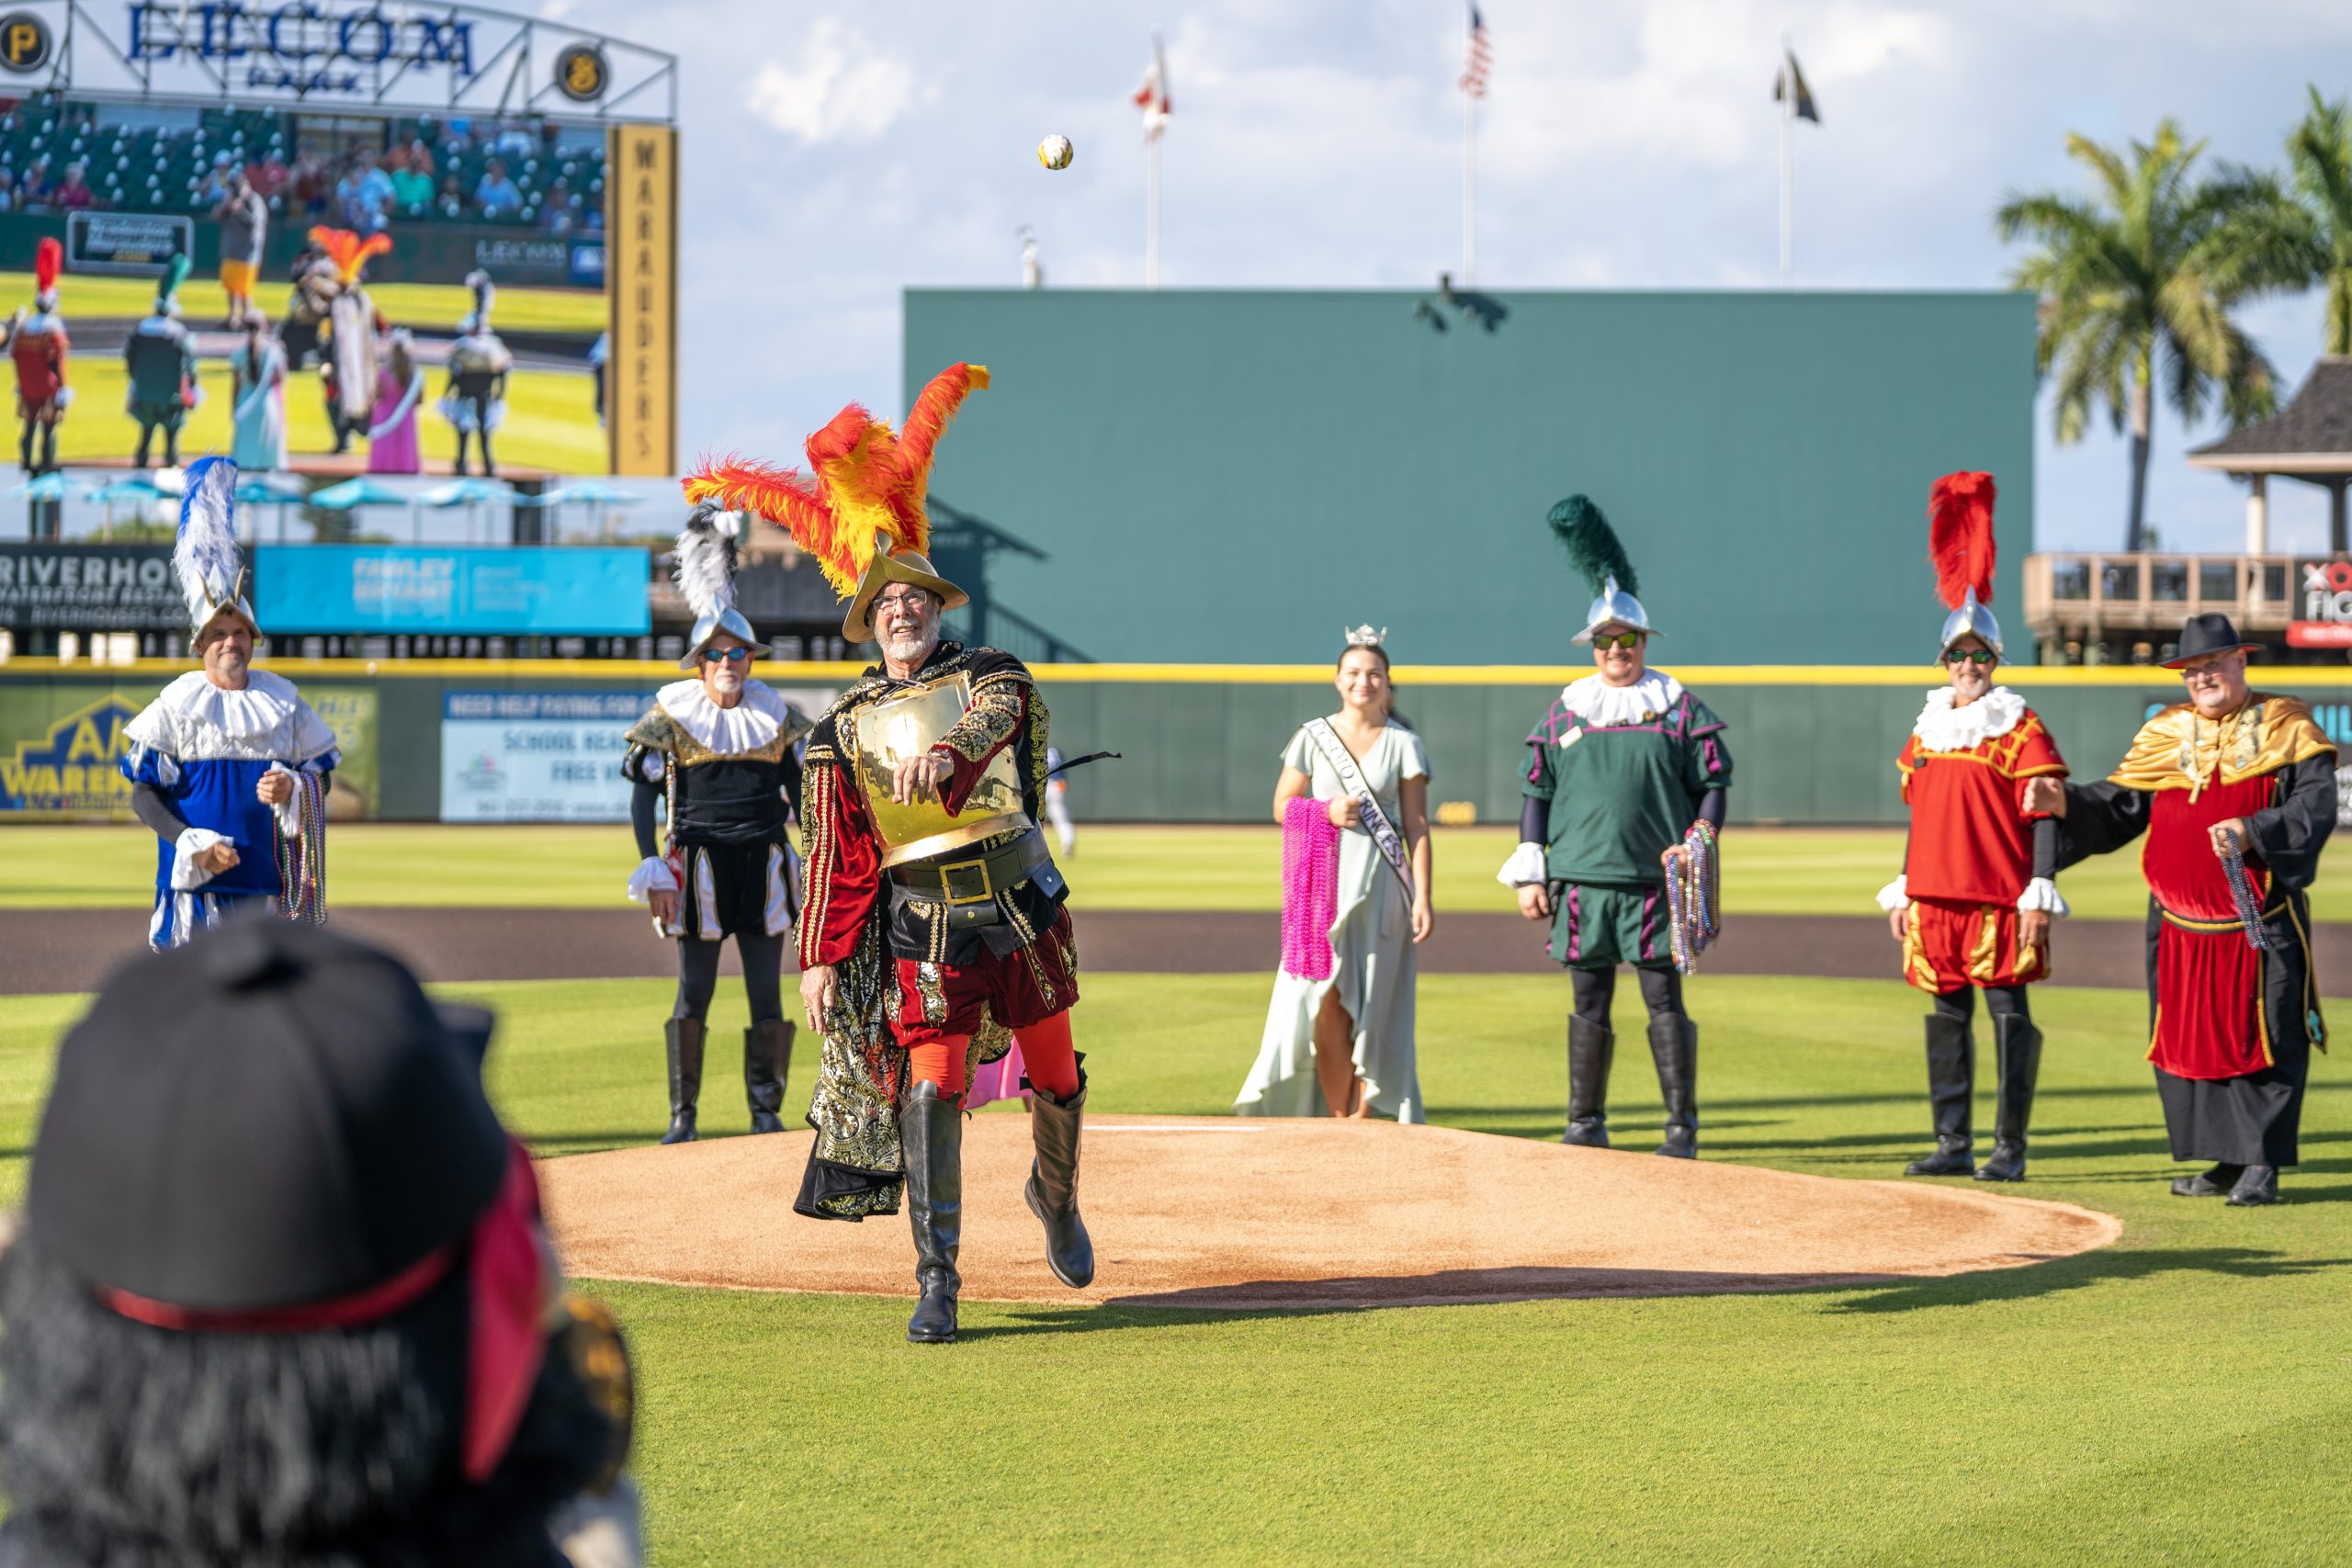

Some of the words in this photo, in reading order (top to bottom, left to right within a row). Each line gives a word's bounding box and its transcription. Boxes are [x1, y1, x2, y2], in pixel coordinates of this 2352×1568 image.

[10, 24, 37, 62] P
[126, 3, 473, 76] LECOM
[633, 138, 656, 457] MARAUDERS
[504, 729, 577, 751] SCHOOL
[551, 761, 596, 782] FREE
